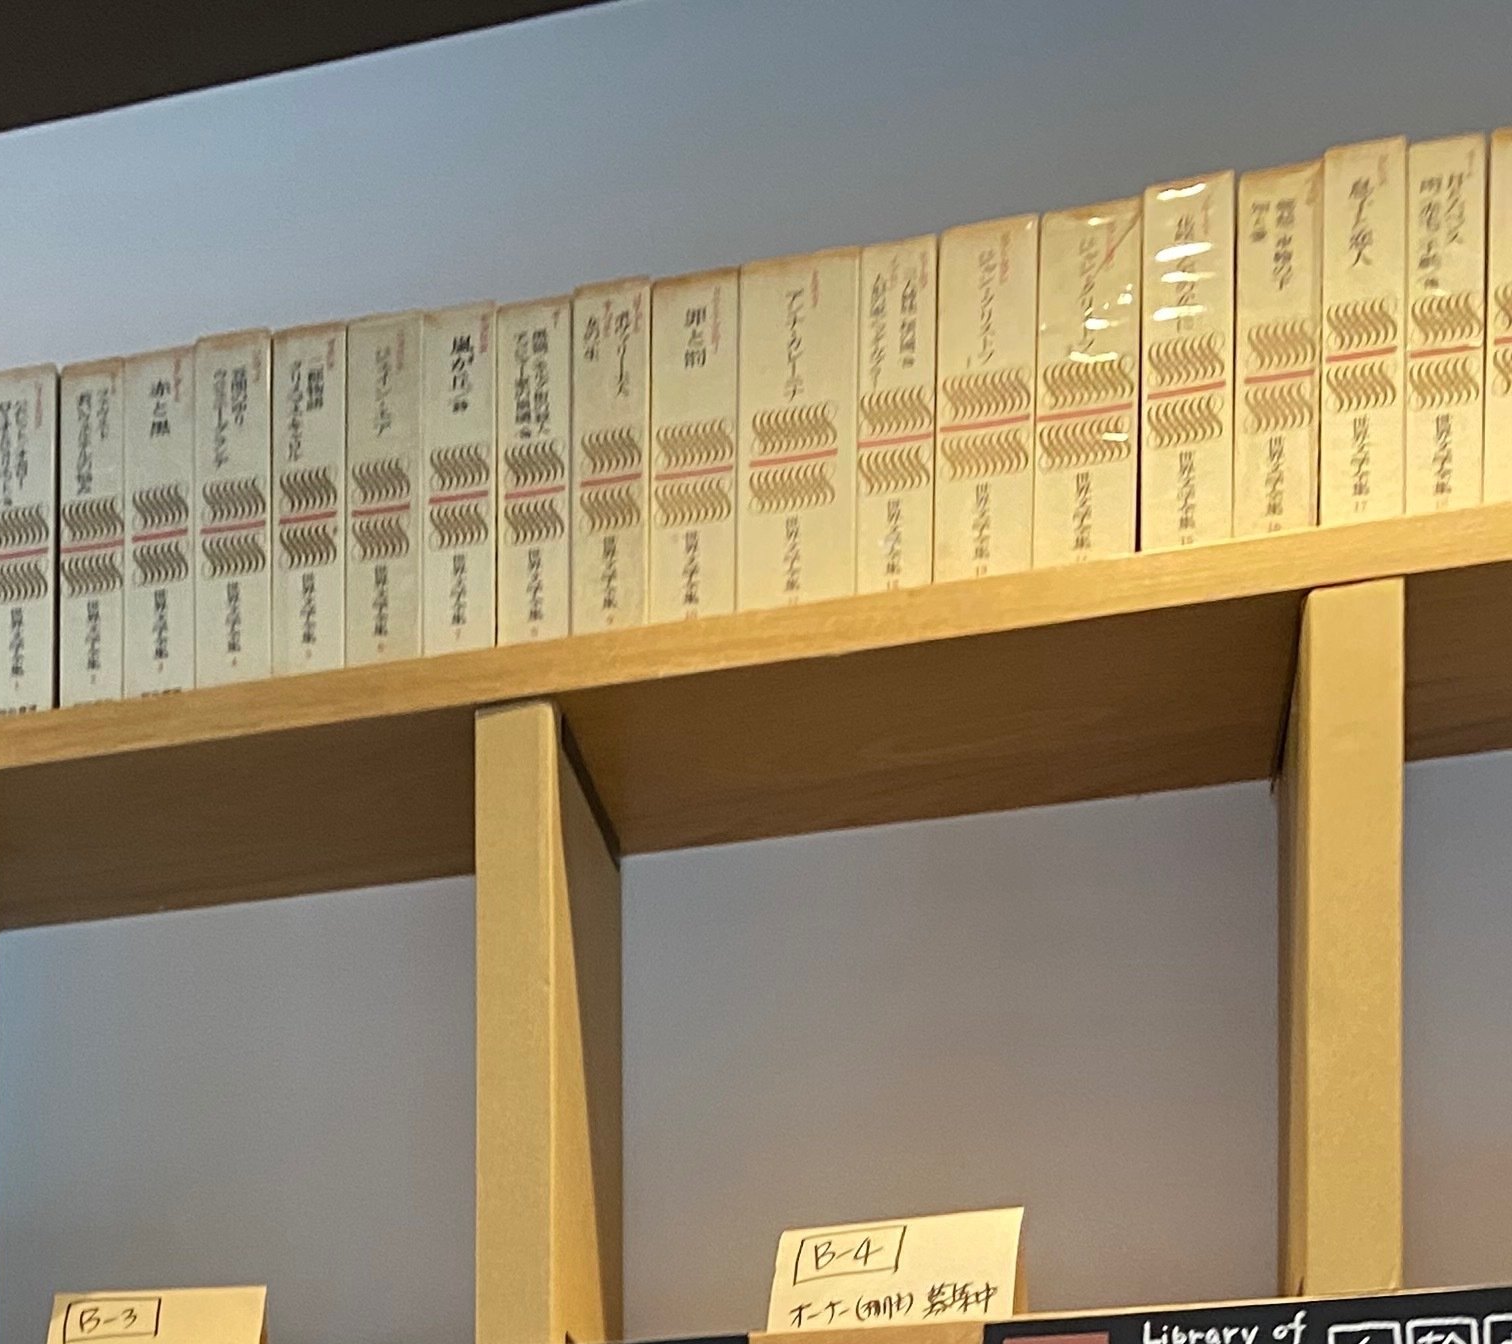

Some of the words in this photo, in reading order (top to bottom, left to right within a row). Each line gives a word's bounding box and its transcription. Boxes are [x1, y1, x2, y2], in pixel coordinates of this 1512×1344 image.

[150, 379, 171, 438] 赤と黒
[814, 1237, 884, 1269] B-4
[79, 1307, 138, 1334] B-3
